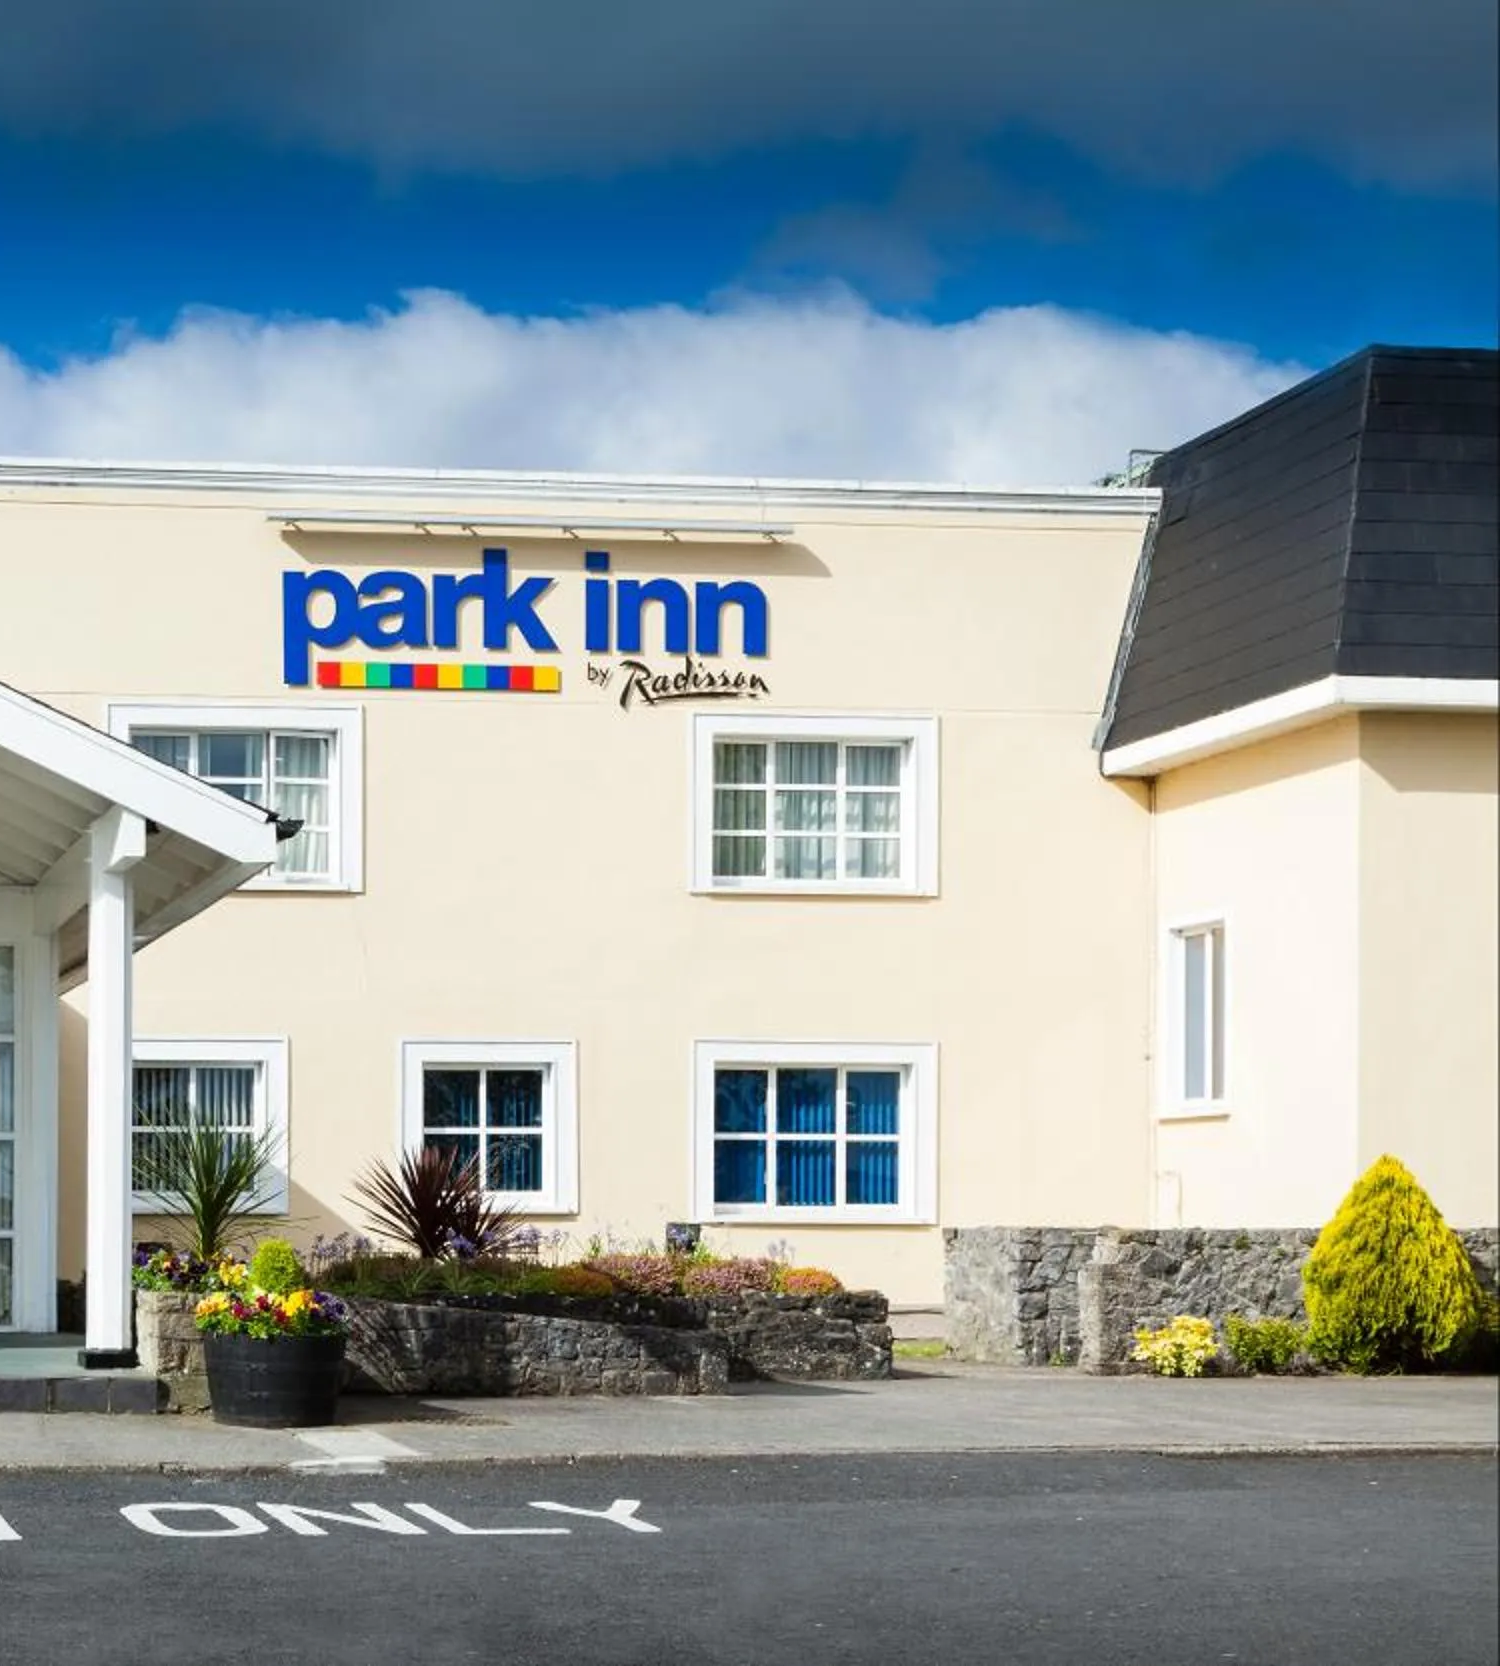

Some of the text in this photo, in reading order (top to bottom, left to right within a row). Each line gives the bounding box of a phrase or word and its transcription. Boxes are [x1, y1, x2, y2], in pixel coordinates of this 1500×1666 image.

[282, 548, 770, 687] park inn
[586, 656, 771, 709] by Radisson
[119, 1498, 662, 1537] ONLY
